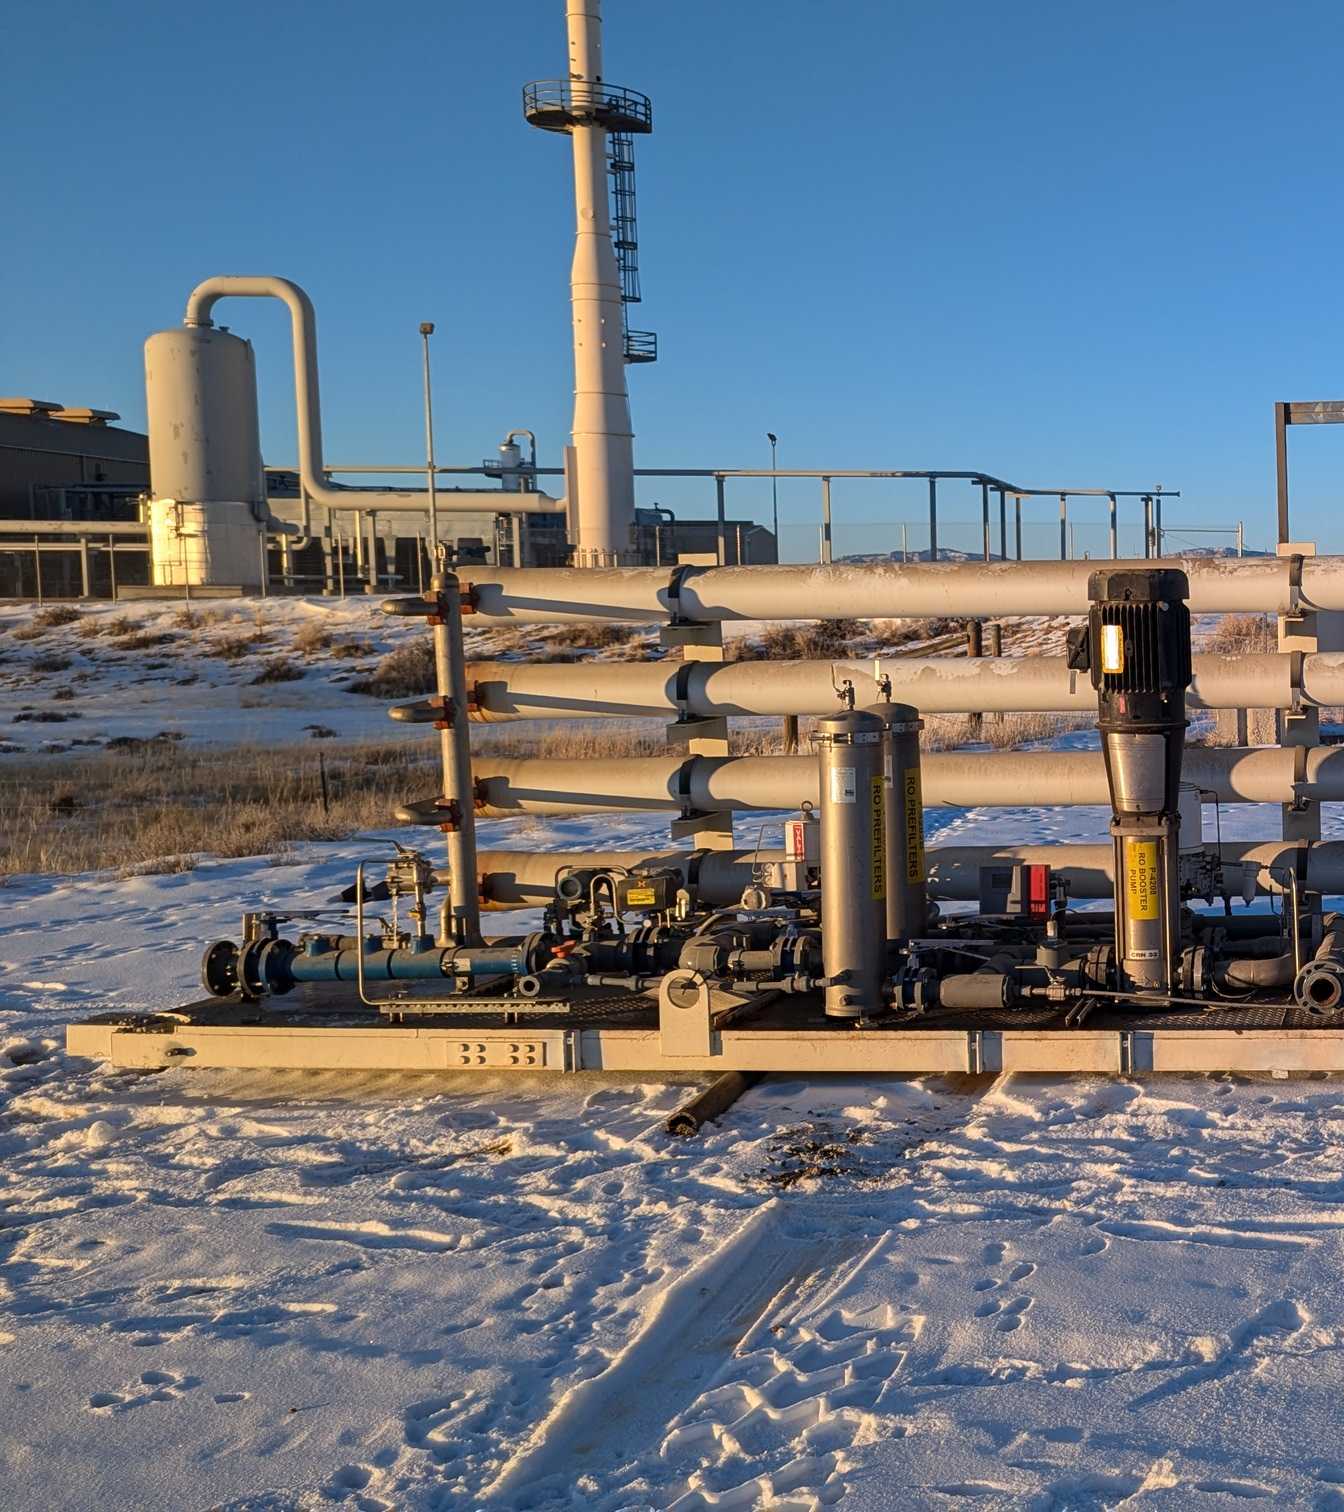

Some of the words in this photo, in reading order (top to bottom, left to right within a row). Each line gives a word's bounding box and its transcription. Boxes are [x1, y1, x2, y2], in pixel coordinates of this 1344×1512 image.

[873, 784, 881, 805] RO
[906, 776, 916, 796] RO
[873, 809, 882, 893] PREFILTERS
[907, 799, 918, 878] PREFILTERS
[1139, 852, 1146, 866] RO
[1130, 869, 1138, 894] PUMP
[1139, 868, 1148, 911] BOOSTER
